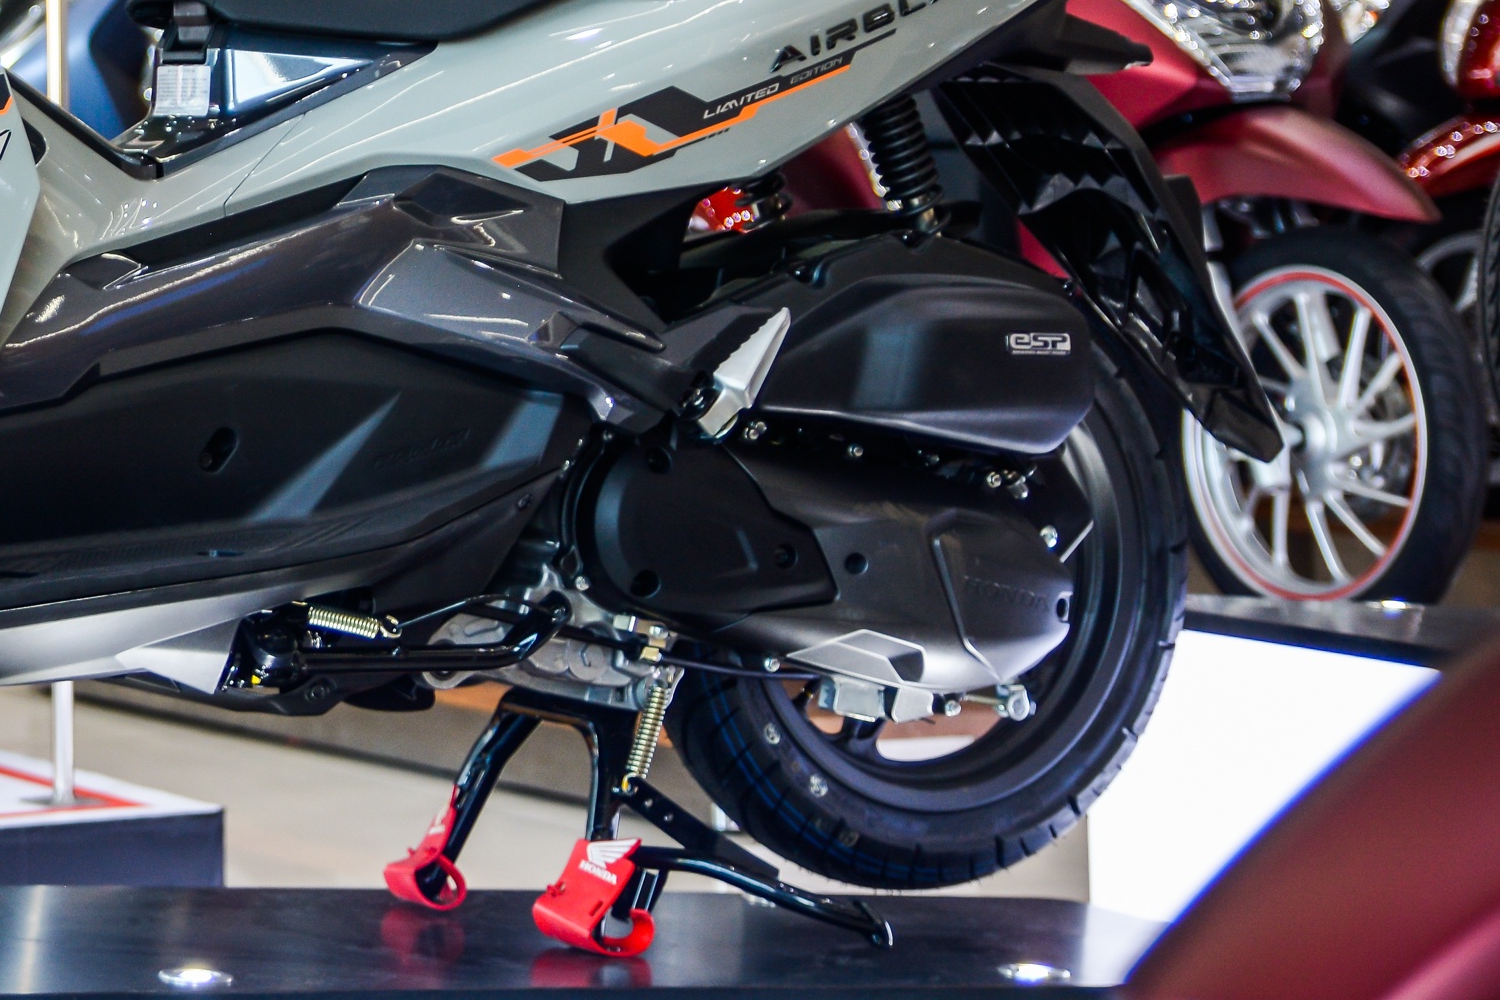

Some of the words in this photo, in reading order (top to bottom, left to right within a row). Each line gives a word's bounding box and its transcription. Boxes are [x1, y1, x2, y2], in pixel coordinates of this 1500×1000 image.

[703, 82, 780, 120] LIMITED
[790, 56, 843, 85] EDITION
[578, 859, 617, 886] HONDA
